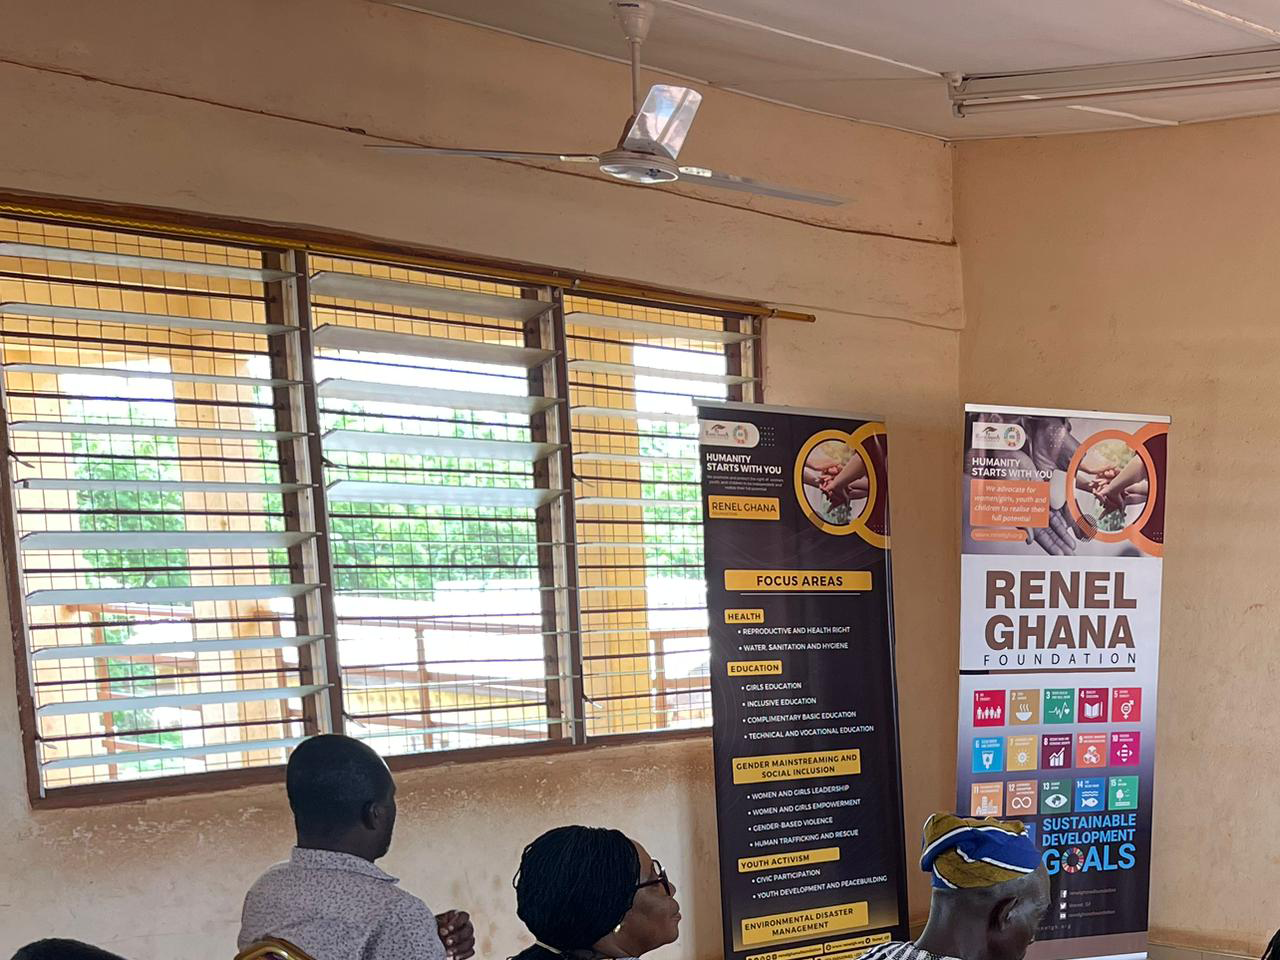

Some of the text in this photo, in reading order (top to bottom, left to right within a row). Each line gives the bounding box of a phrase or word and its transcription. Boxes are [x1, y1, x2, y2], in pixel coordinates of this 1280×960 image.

[706, 453, 752, 464] HUMANITY
[972, 457, 1021, 467] HUMANITY
[706, 462, 782, 475] STARTS WITH YOU
[971, 467, 1053, 479] STARTS WITH YOU
[996, 485, 1025, 494] advocate
[711, 502, 777, 513] RENEL GHANA
[1002, 514, 1032, 523] potential
[756, 575, 843, 587] FOCUS AREAS
[985, 570, 1137, 609] RENEL
[727, 612, 761, 621] HEALTH
[742, 625, 851, 636] REPRODUCTIVE AND HEALTH RIGHT
[984, 614, 1136, 651] GHANA
[768, 643, 806, 651] SANITATION
[822, 642, 849, 650] HYGIENE
[983, 653, 1136, 666] FOUNDATION
[730, 664, 779, 673] EDUCATION
[745, 682, 802, 692] GIRLS EDUCATION
[975, 692, 979, 702] 1
[1011, 692, 1017, 701] 2
[1045, 691, 1051, 700] 3
[1080, 690, 1085, 699] 4
[1113, 690, 1119, 698] 5
[747, 697, 817, 708] INCLUSIVE EDUCATION
[747, 711, 857, 724] COMPLIMENTARY BASIC EDUCATION
[748, 725, 874, 741] TECHNICAL AND VOCATIONAL EDUCATION
[1112, 734, 1119, 743] 10
[1043, 737, 1049, 746] 8
[1078, 735, 1084, 744] 9
[736, 754, 857, 771] GENDER MAINSTREAMING AND
[761, 766, 836, 779] SOCIAL INCLUSION
[1008, 784, 1015, 792] 12
[1042, 782, 1050, 791] 13
[1076, 781, 1084, 789] 14
[1110, 778, 1117, 787] 15
[751, 784, 850, 800] WOMEN AND GIRLS LEADERSHIP
[752, 798, 861, 816] WOMEN AND GIRLS EMPOWERMENT
[752, 816, 834, 832] GENDER-BASED VIOLENCE
[1042, 813, 1137, 832] SUSTAINABLE
[754, 829, 859, 848] HUMAN TRAFFICKING AND RESCUE
[1042, 829, 1136, 847] DEVELOPMENT
[740, 854, 811, 870] YOUTH ACTIVISM
[1042, 843, 1136, 875] GOALS
[756, 869, 821, 884] CIVIC PARTICIPATION
[756, 874, 888, 899] YOUTH DEVELOPMENT AND PEACEBUILDING
[744, 907, 854, 931] ENVIRONMENTAL DISASTER
[772, 921, 829, 937] MANAGEMENT
